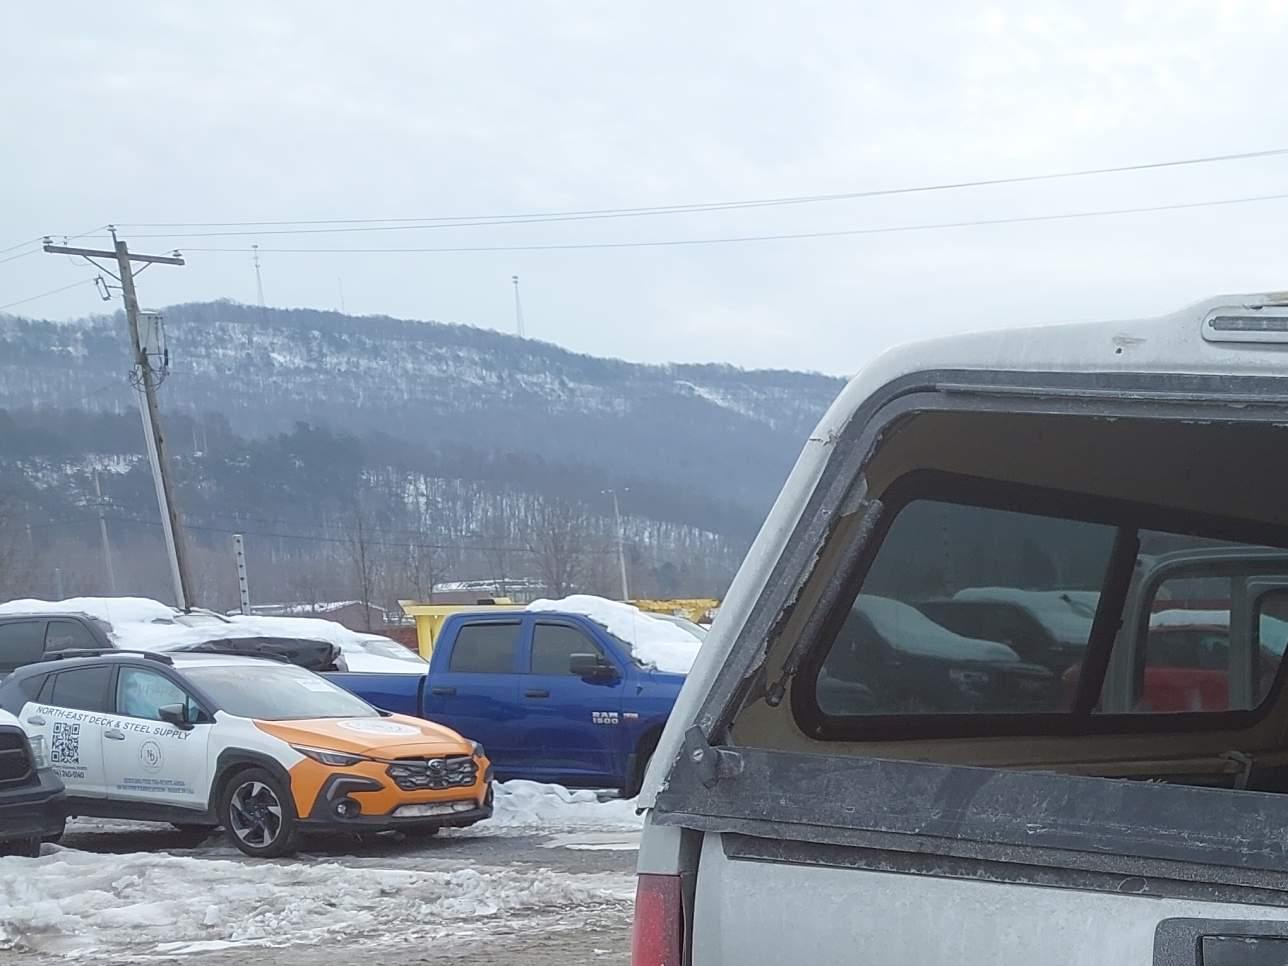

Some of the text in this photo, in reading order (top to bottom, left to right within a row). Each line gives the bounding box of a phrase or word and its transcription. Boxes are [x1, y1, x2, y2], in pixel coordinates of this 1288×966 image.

[36, 706, 191, 740] NORTH-EAST DECK & STEEL SUPPLY
